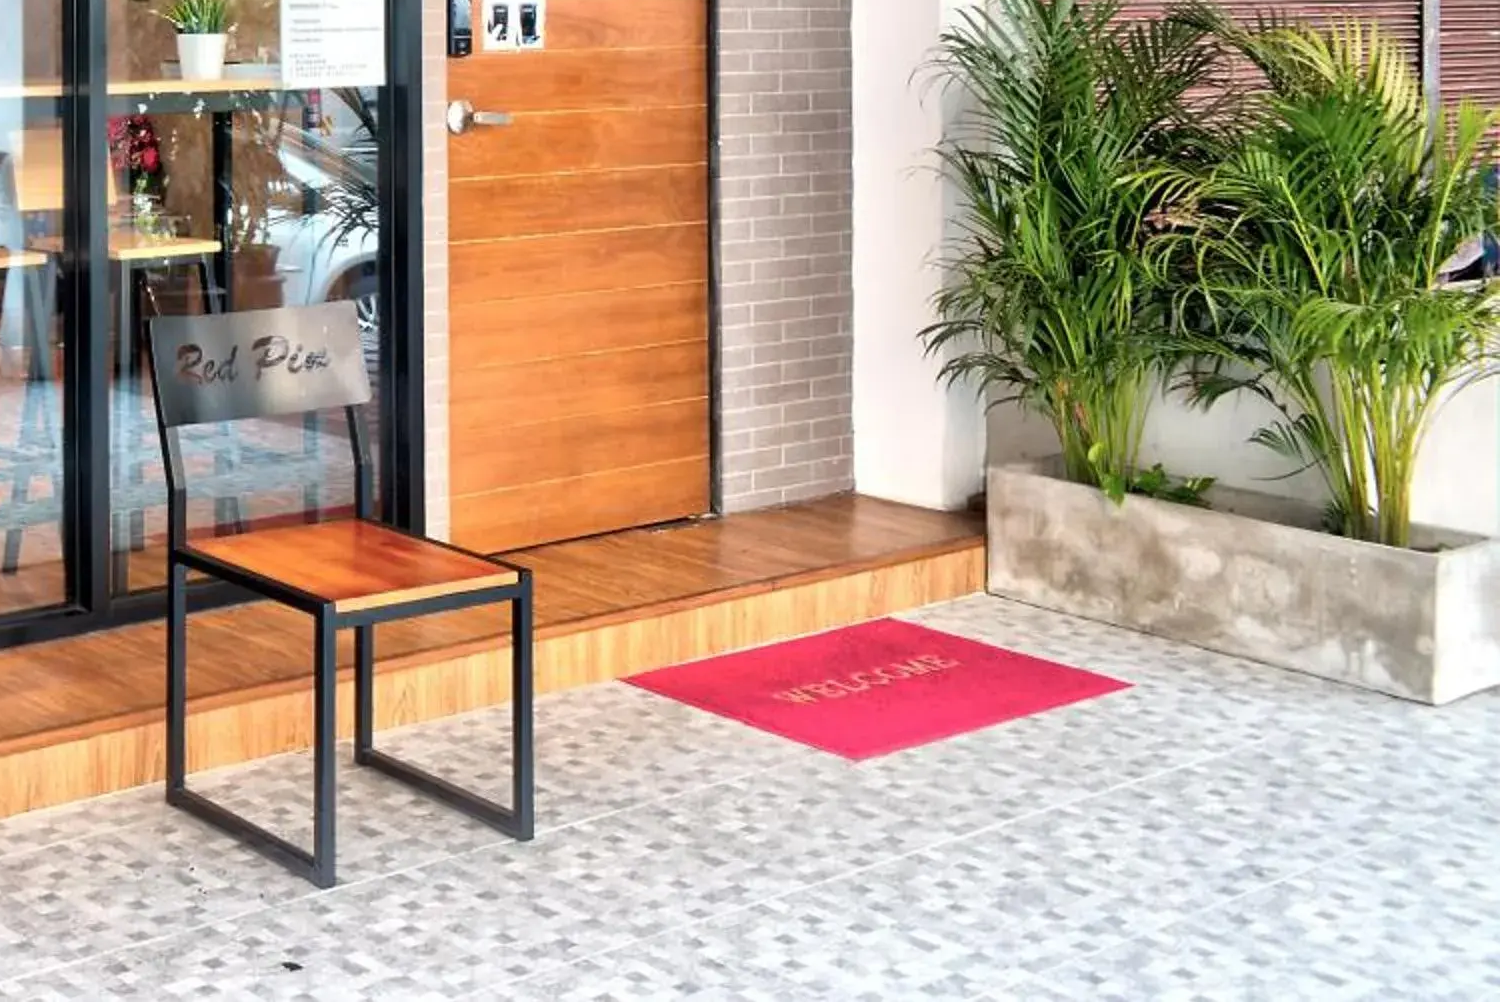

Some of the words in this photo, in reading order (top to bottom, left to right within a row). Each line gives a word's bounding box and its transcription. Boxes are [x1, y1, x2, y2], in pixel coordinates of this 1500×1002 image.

[176, 344, 239, 385] Red
[252, 334, 331, 381] Pin
[773, 654, 963, 706] WELCOME
